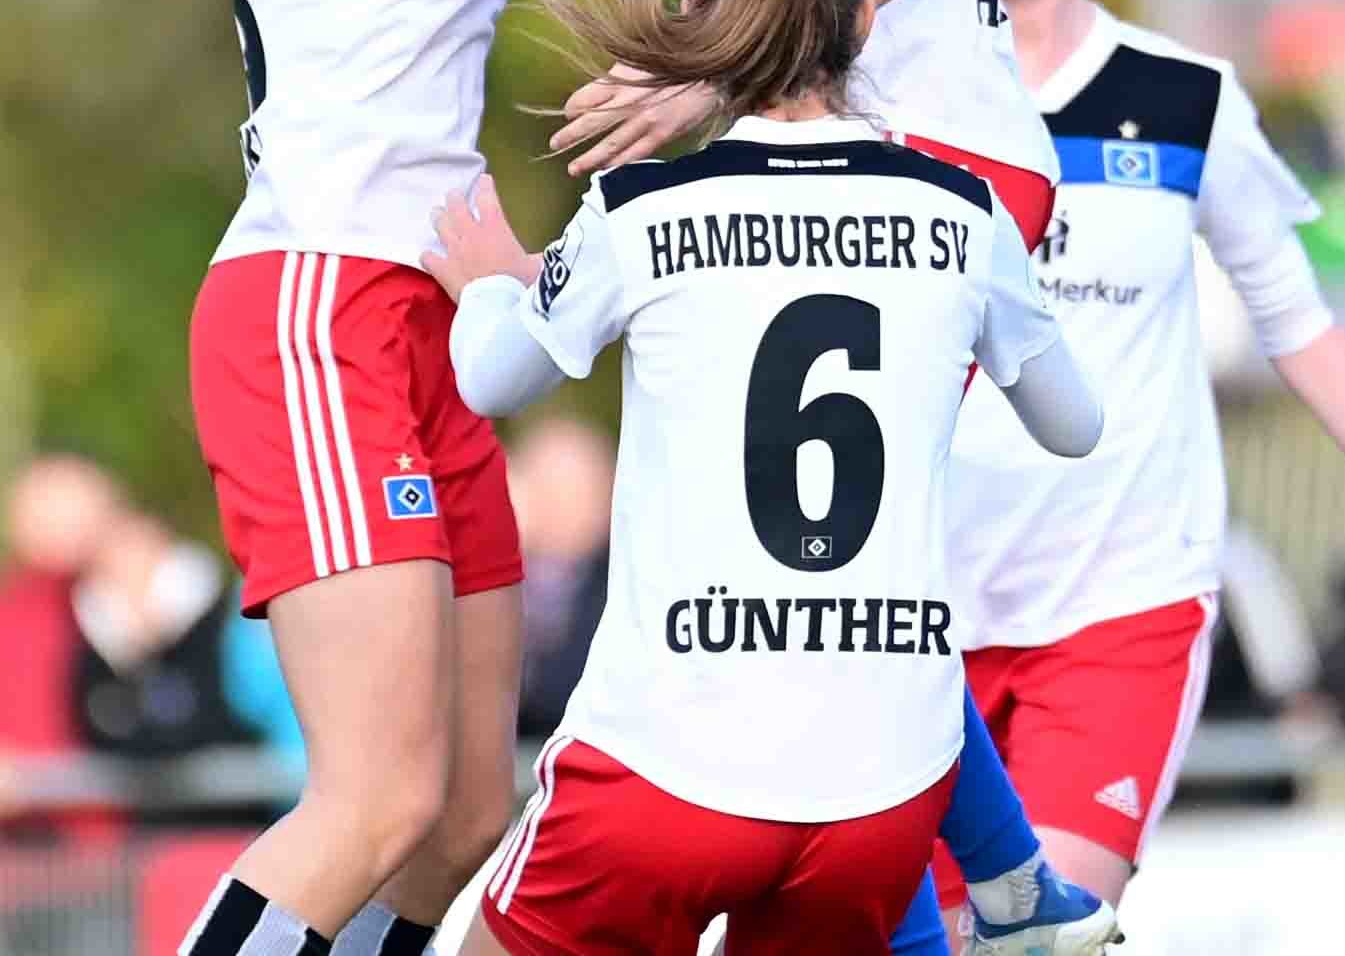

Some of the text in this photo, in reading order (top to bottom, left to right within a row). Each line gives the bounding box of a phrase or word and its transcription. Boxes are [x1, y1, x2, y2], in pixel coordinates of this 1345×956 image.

[646, 212, 969, 279] HAMBURGER SV
[743, 293, 886, 573] 6
[665, 585, 952, 656] GÜNTHER
